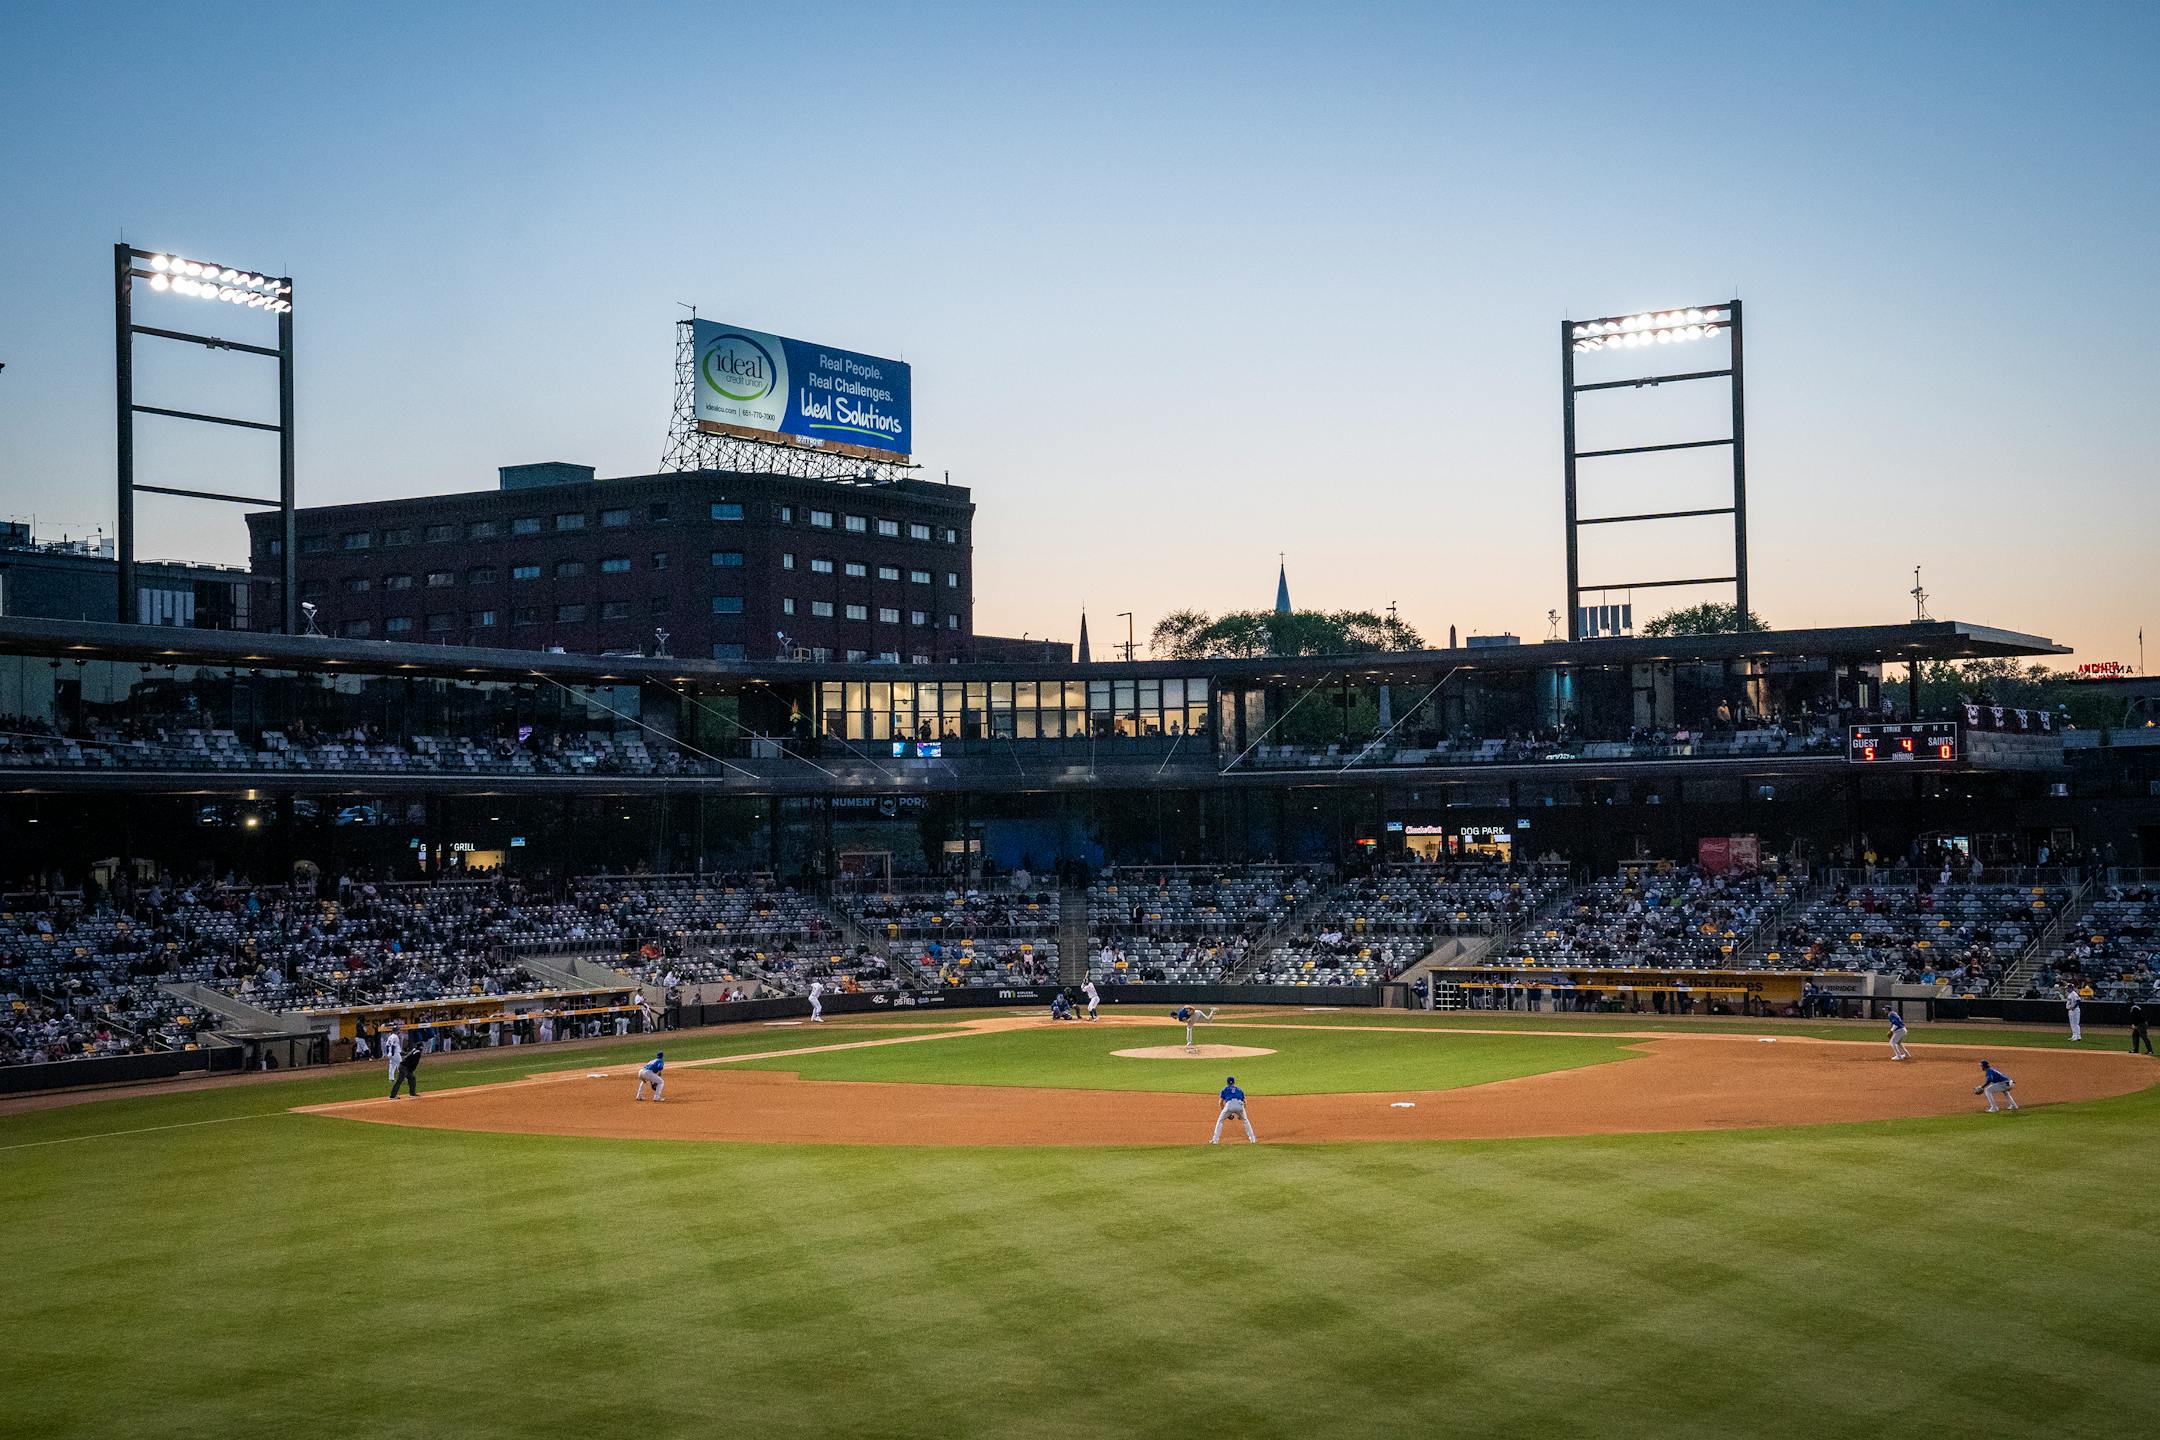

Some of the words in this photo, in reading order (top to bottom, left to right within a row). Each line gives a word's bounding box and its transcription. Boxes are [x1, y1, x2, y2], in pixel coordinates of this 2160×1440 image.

[716, 349, 764, 379] ideal
[819, 353, 843, 372] Real
[845, 361, 883, 380] People.
[725, 375, 745, 385] credit
[745, 378, 763, 388] union
[809, 372, 833, 391] Real
[834, 377, 894, 402] Challenges.
[800, 387, 832, 421] Ideal
[836, 396, 903, 434] Solutions
[1852, 739, 1879, 748] GUEST
[1928, 736, 1954, 747] SAINTS
[1902, 739, 1912, 751] 4
[1865, 748, 1874, 760] 5
[1892, 753, 1914, 761] INNING
[1941, 745, 1950, 759] 0
[1460, 827, 1480, 836] DOG
[1481, 826, 1505, 835] PARK
[454, 842, 476, 852] GRILL
